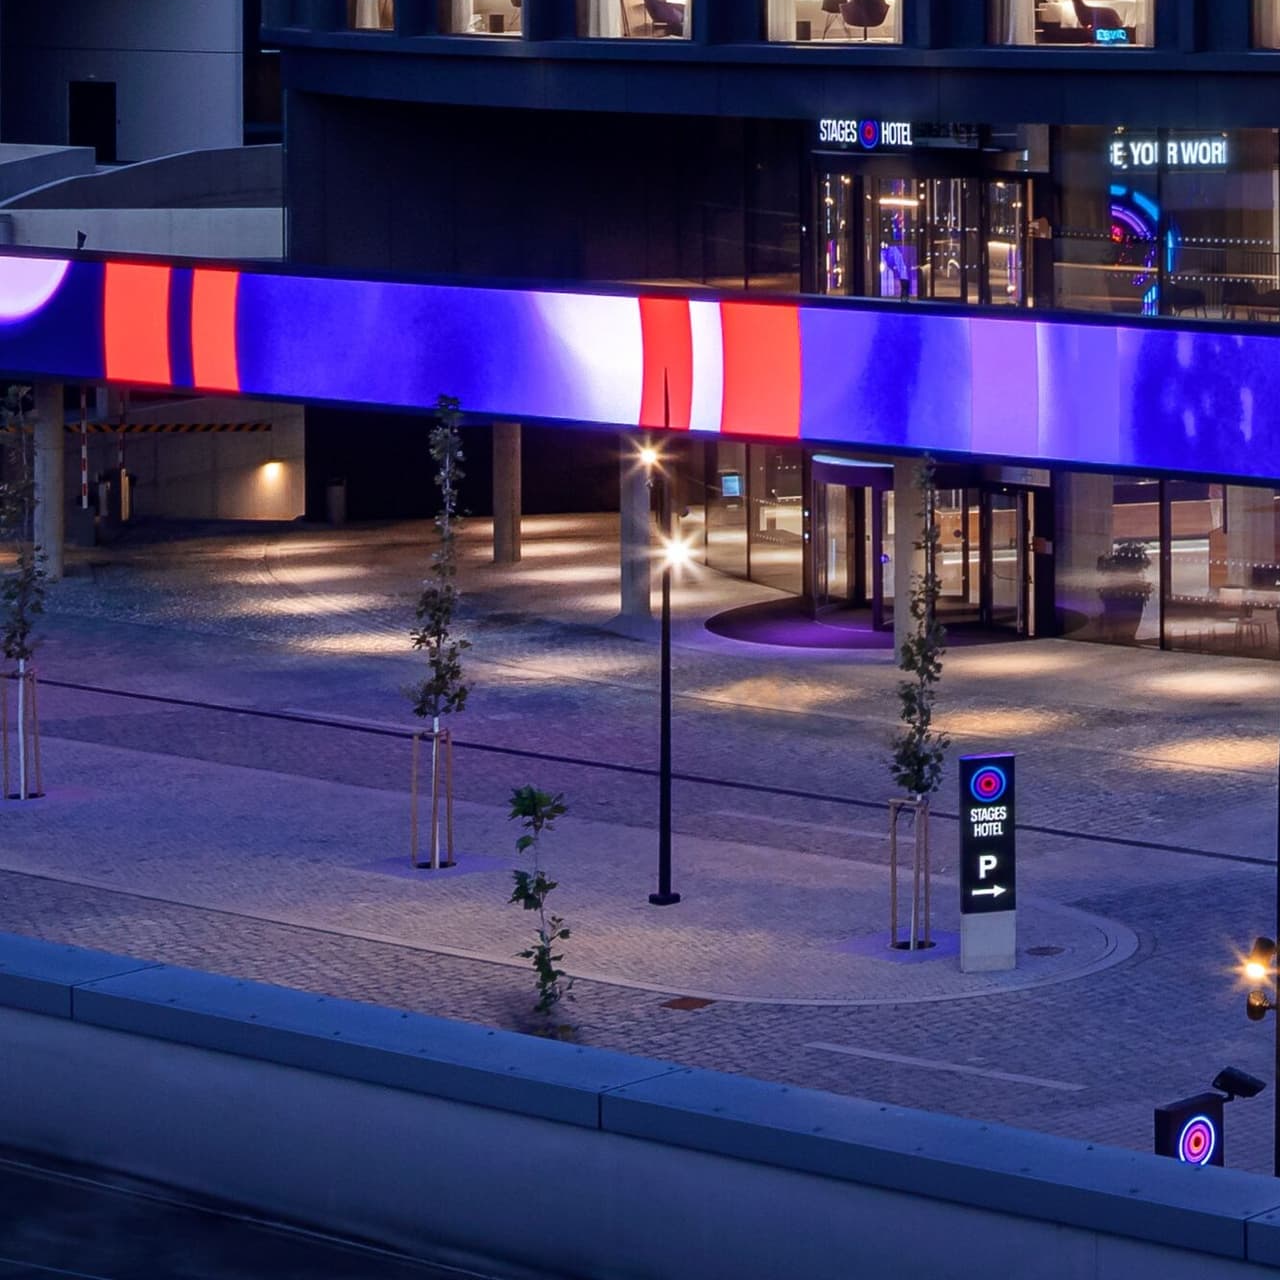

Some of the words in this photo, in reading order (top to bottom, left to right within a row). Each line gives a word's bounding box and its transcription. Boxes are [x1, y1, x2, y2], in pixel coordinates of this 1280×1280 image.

[819, 119, 857, 143] STAGES
[881, 121, 913, 146] HOTEL
[970, 806, 1008, 822] STAGES
[973, 822, 1004, 838] HOTEL
[979, 854, 998, 879] P
